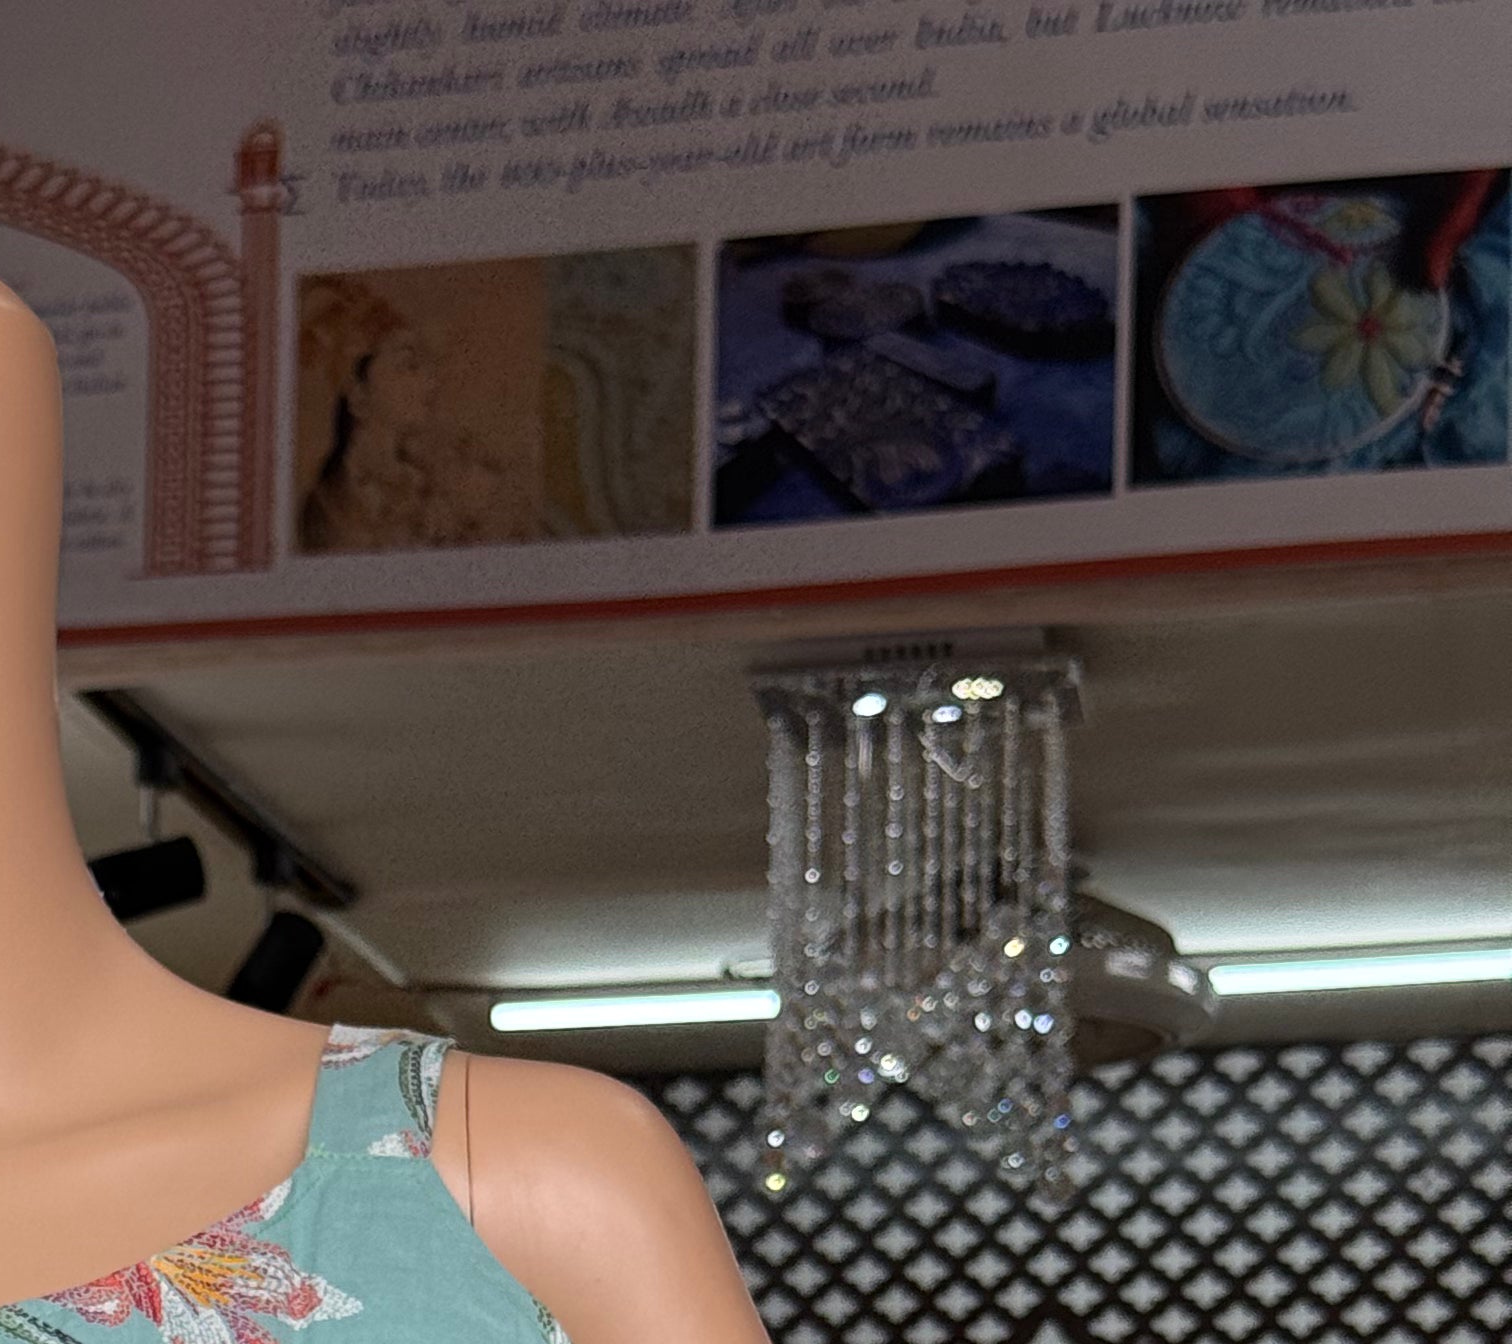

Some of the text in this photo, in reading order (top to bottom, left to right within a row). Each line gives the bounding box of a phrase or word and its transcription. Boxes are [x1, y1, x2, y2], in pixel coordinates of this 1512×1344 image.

[770, 27, 820, 63] all
[828, 29, 900, 57] over
[1026, 5, 1079, 37] but
[441, 161, 488, 193] the
[926, 115, 1054, 147] remains
[1061, 111, 1084, 135] a
[1088, 87, 1198, 144] global
[521, 100, 591, 137] with
